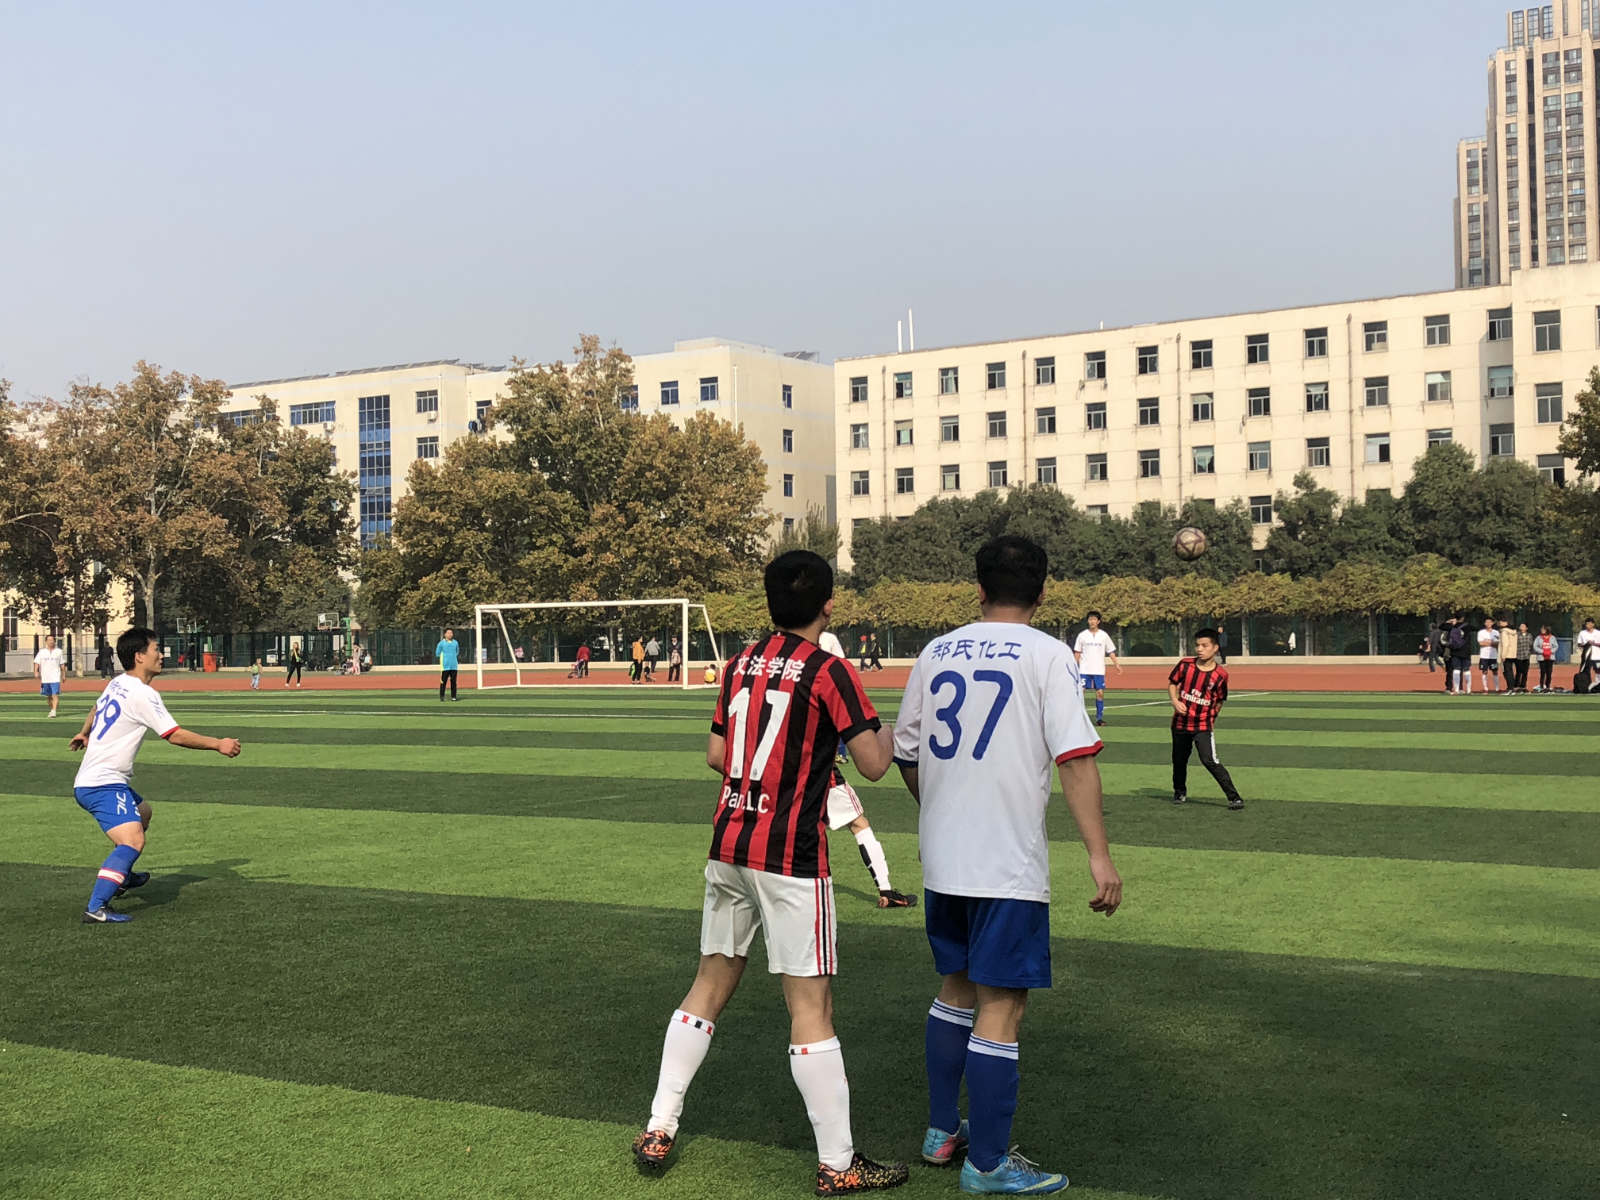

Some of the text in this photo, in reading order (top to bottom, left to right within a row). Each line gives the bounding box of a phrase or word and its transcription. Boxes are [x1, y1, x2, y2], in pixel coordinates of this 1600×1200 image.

[733, 654, 806, 682] 文法学院
[929, 670, 1013, 760] 37
[1181, 690, 1211, 706] Emirates
[728, 687, 791, 781] 17
